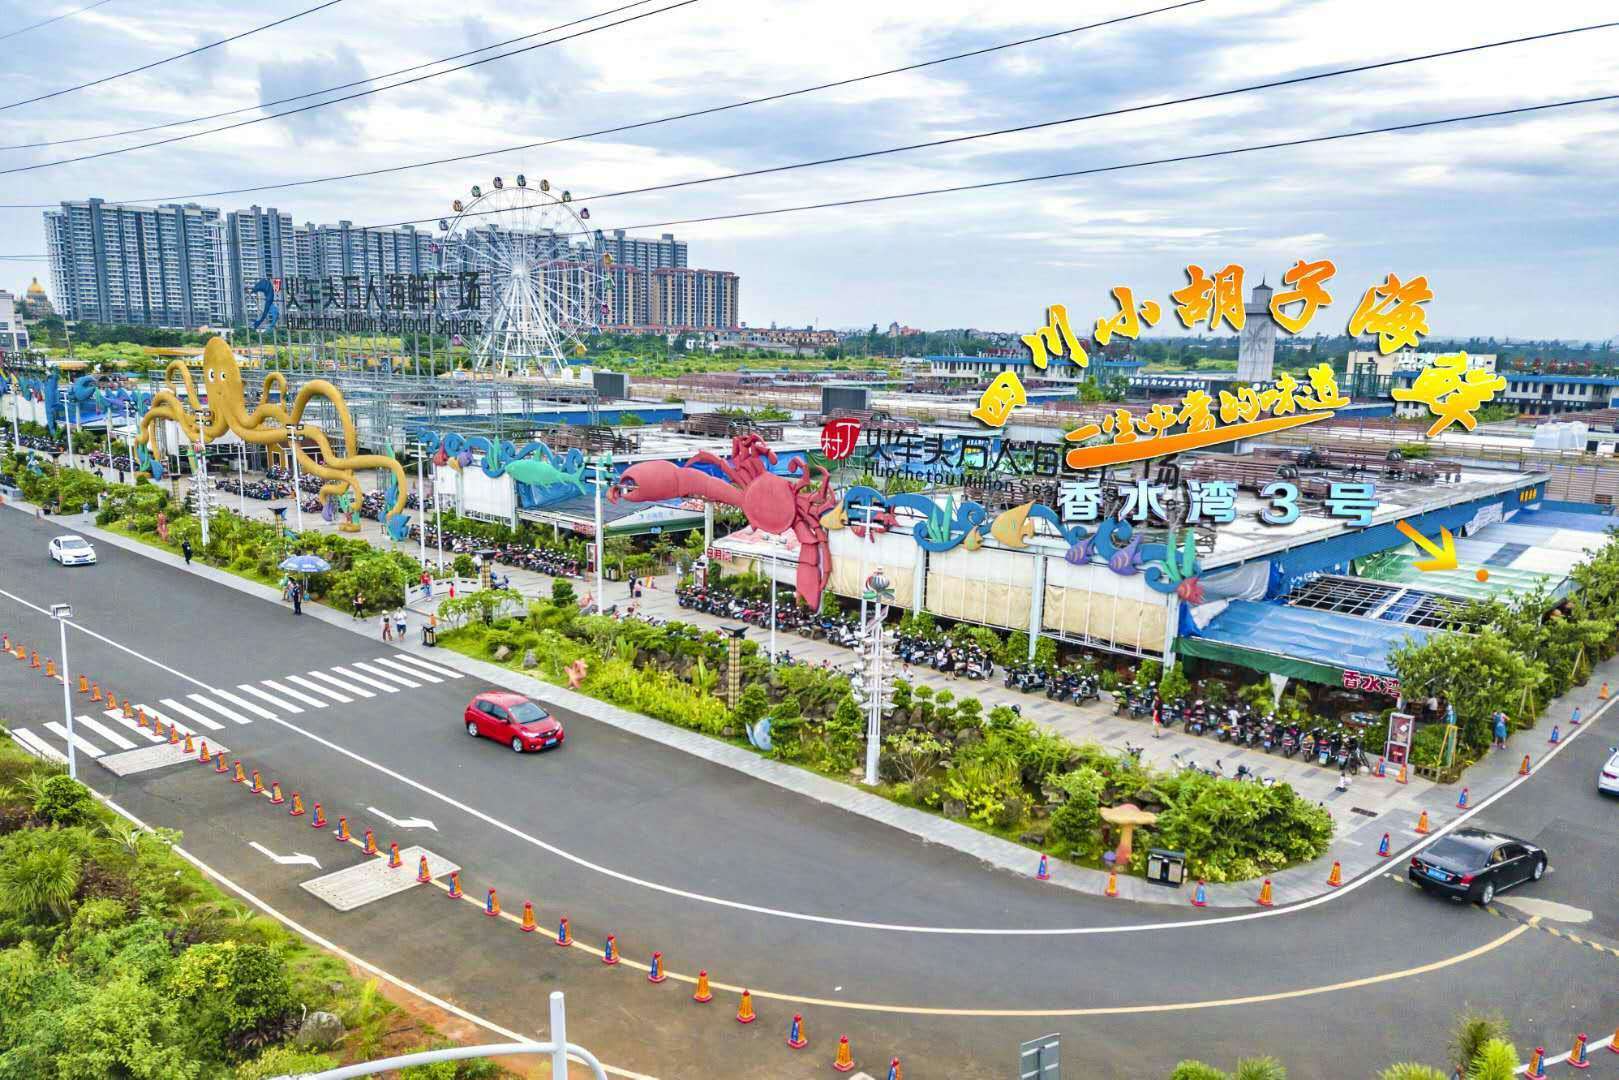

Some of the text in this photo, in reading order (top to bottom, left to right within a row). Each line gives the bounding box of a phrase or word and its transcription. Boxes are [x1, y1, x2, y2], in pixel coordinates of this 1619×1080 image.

[285, 272, 481, 311] 火车头万人海鲜广场
[379, 316, 431, 336] Seafood
[435, 318, 482, 337] Square
[864, 463, 955, 486] Huochetou
[961, 473, 1014, 492] Million
